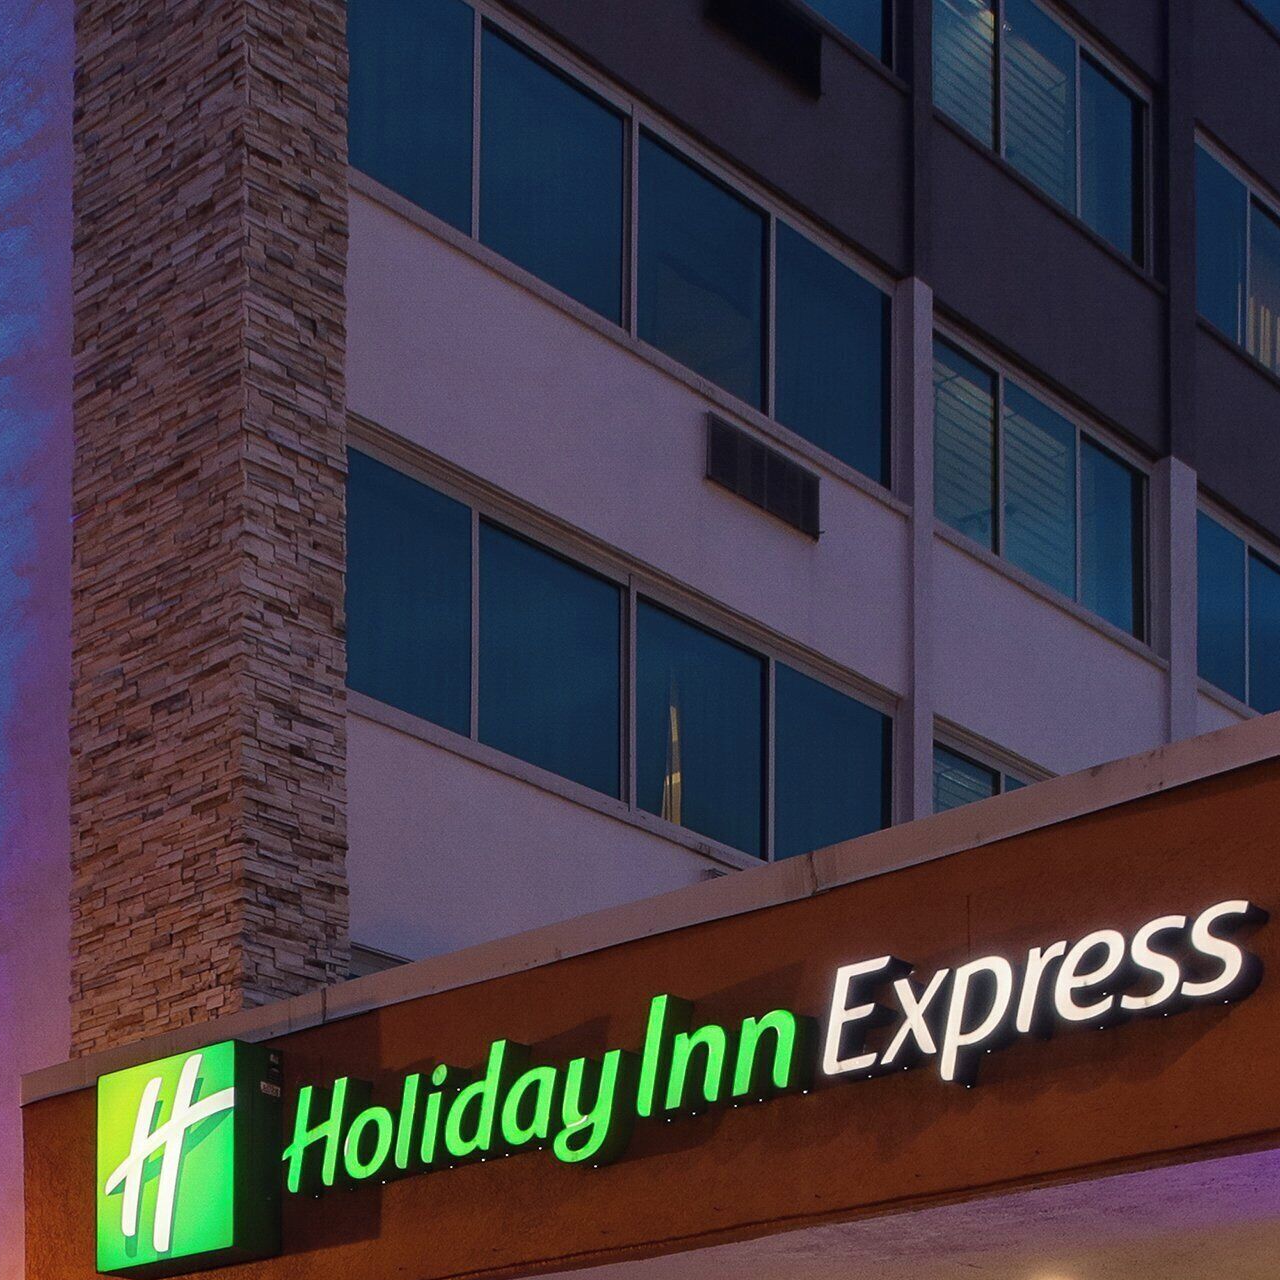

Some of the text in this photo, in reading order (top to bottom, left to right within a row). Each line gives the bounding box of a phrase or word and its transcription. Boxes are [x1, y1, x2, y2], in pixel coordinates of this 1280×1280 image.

[281, 1038, 623, 1194] Holiday
[635, 994, 798, 1118] Inn
[821, 900, 1250, 1083] Express
